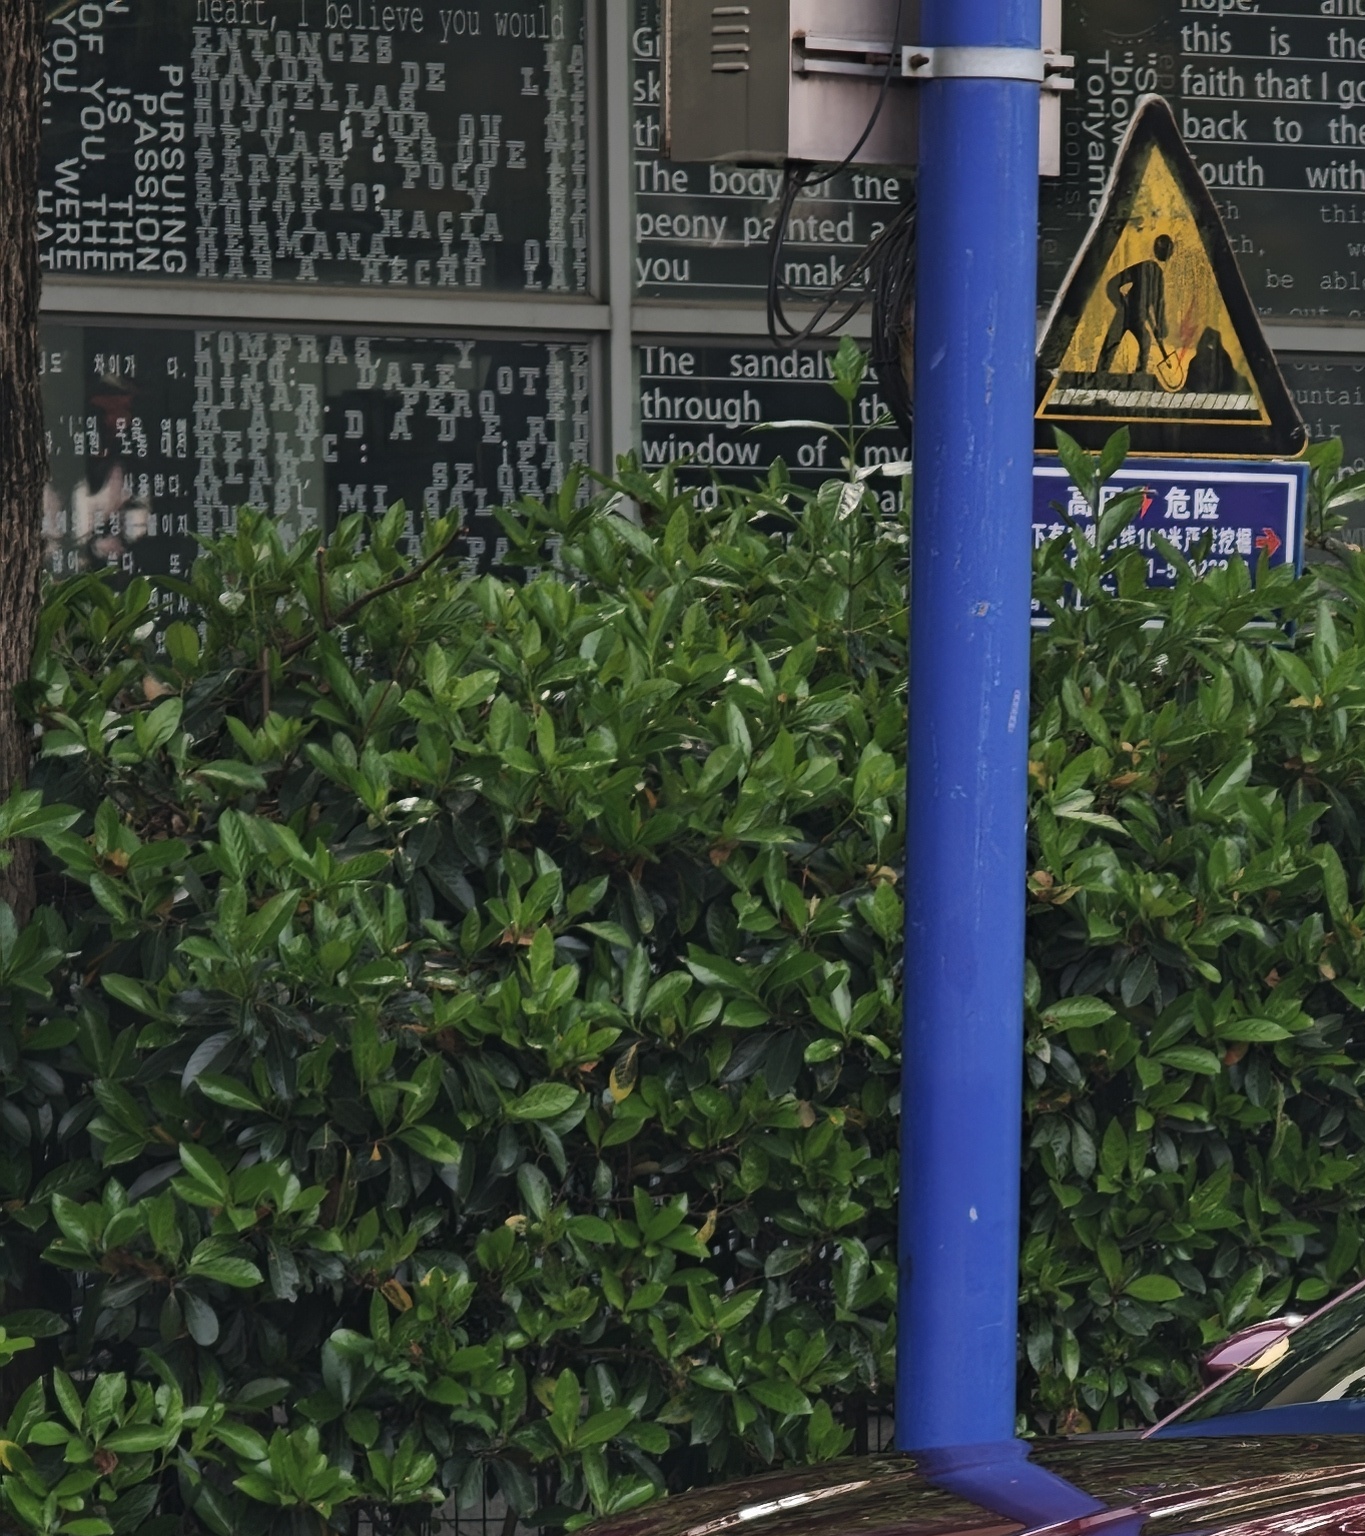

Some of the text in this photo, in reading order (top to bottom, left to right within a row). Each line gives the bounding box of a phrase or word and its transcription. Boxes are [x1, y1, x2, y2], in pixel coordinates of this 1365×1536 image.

[78, 3, 103, 54] OF
[325, 0, 424, 33] believe
[439, 9, 482, 44] you
[494, 5, 565, 41] would
[1180, 22, 1232, 54] this
[1270, 26, 1291, 56] is
[192, 27, 393, 64] ENTONCES
[401, 62, 446, 91] DE
[1180, 64, 1245, 97] faith
[1254, 68, 1312, 100] that
[52, 9, 80, 270] YOU WERE
[1183, 108, 1248, 140] back
[1273, 116, 1303, 143] to
[106, 87, 133, 272] IS THE
[134, 94, 160, 271] PASSION
[160, 65, 186, 273] PURSUING
[401, 160, 491, 192] POCO
[634, 161, 689, 193] The
[709, 165, 784, 204] body
[1195, 155, 1264, 187] outh
[82, 193, 107, 270] THE
[379, 208, 503, 241] HACIA
[636, 212, 728, 248] peony
[743, 211, 854, 247] panted
[636, 256, 690, 288] you
[1265, 269, 1294, 289] be
[454, 340, 476, 369] Y
[640, 346, 695, 376] The
[400, 387, 497, 418] PERO
[640, 387, 762, 428] through
[642, 433, 761, 466] window
[797, 436, 828, 467] of
[672, 478, 718, 508] ind
[1164, 486, 1220, 520] 危险
